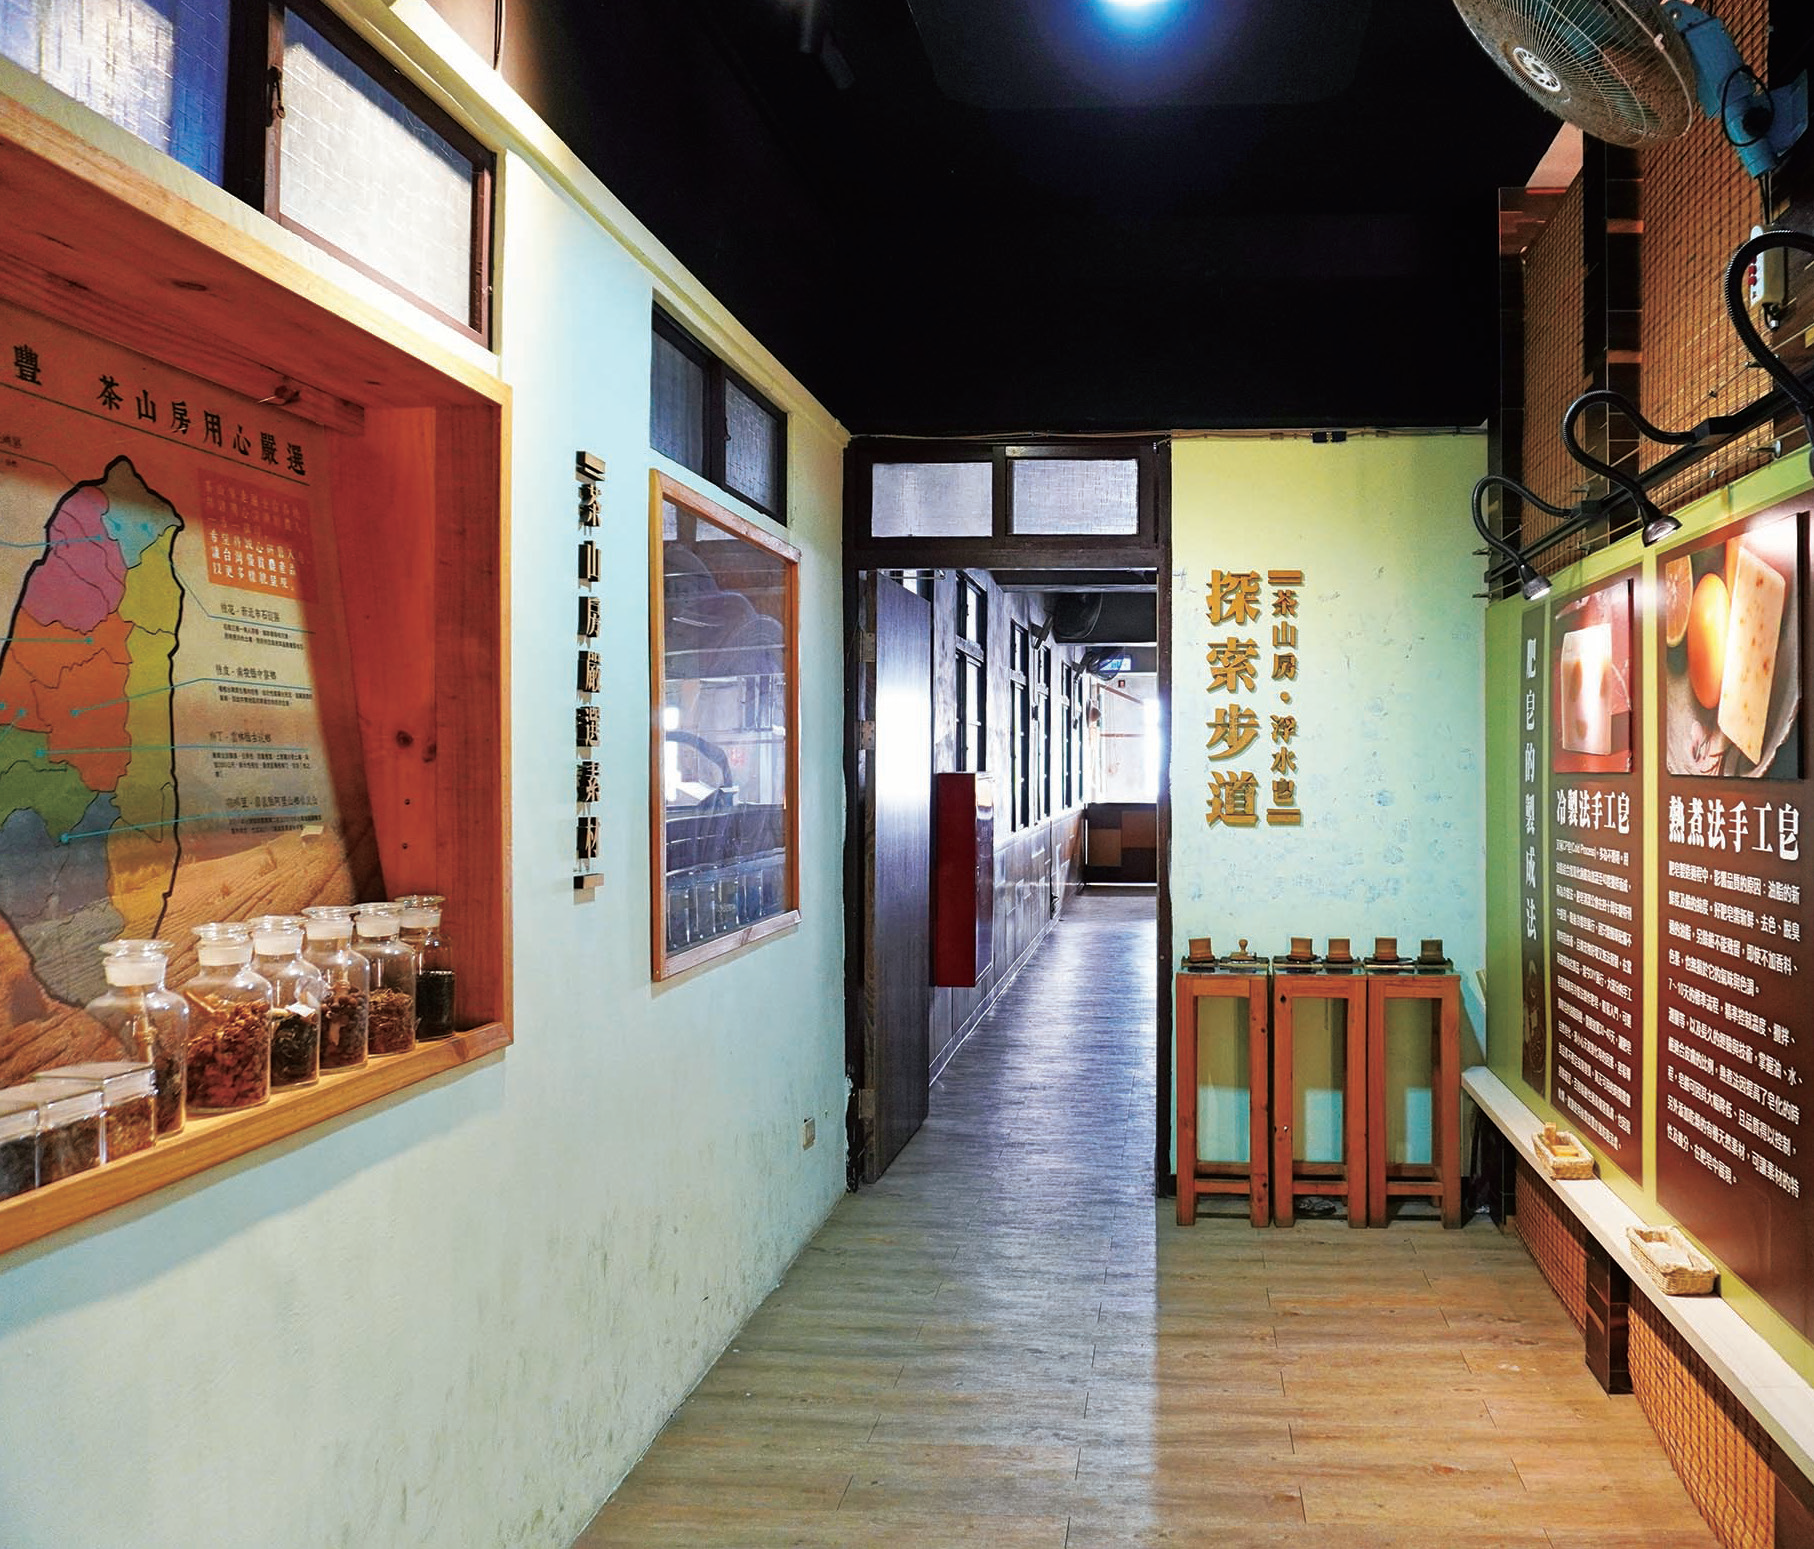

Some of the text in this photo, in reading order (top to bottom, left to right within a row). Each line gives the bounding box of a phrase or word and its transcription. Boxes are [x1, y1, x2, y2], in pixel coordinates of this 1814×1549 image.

[12, 344, 306, 476] 豐 茶山房用心嚴選
[1206, 569, 1262, 827] 探索步道
[1525, 637, 1537, 941] 肥皂的製成法
[1556, 789, 1630, 834] 冷製法手工皂
[1668, 795, 1799, 861] 熱煮法手工皂
